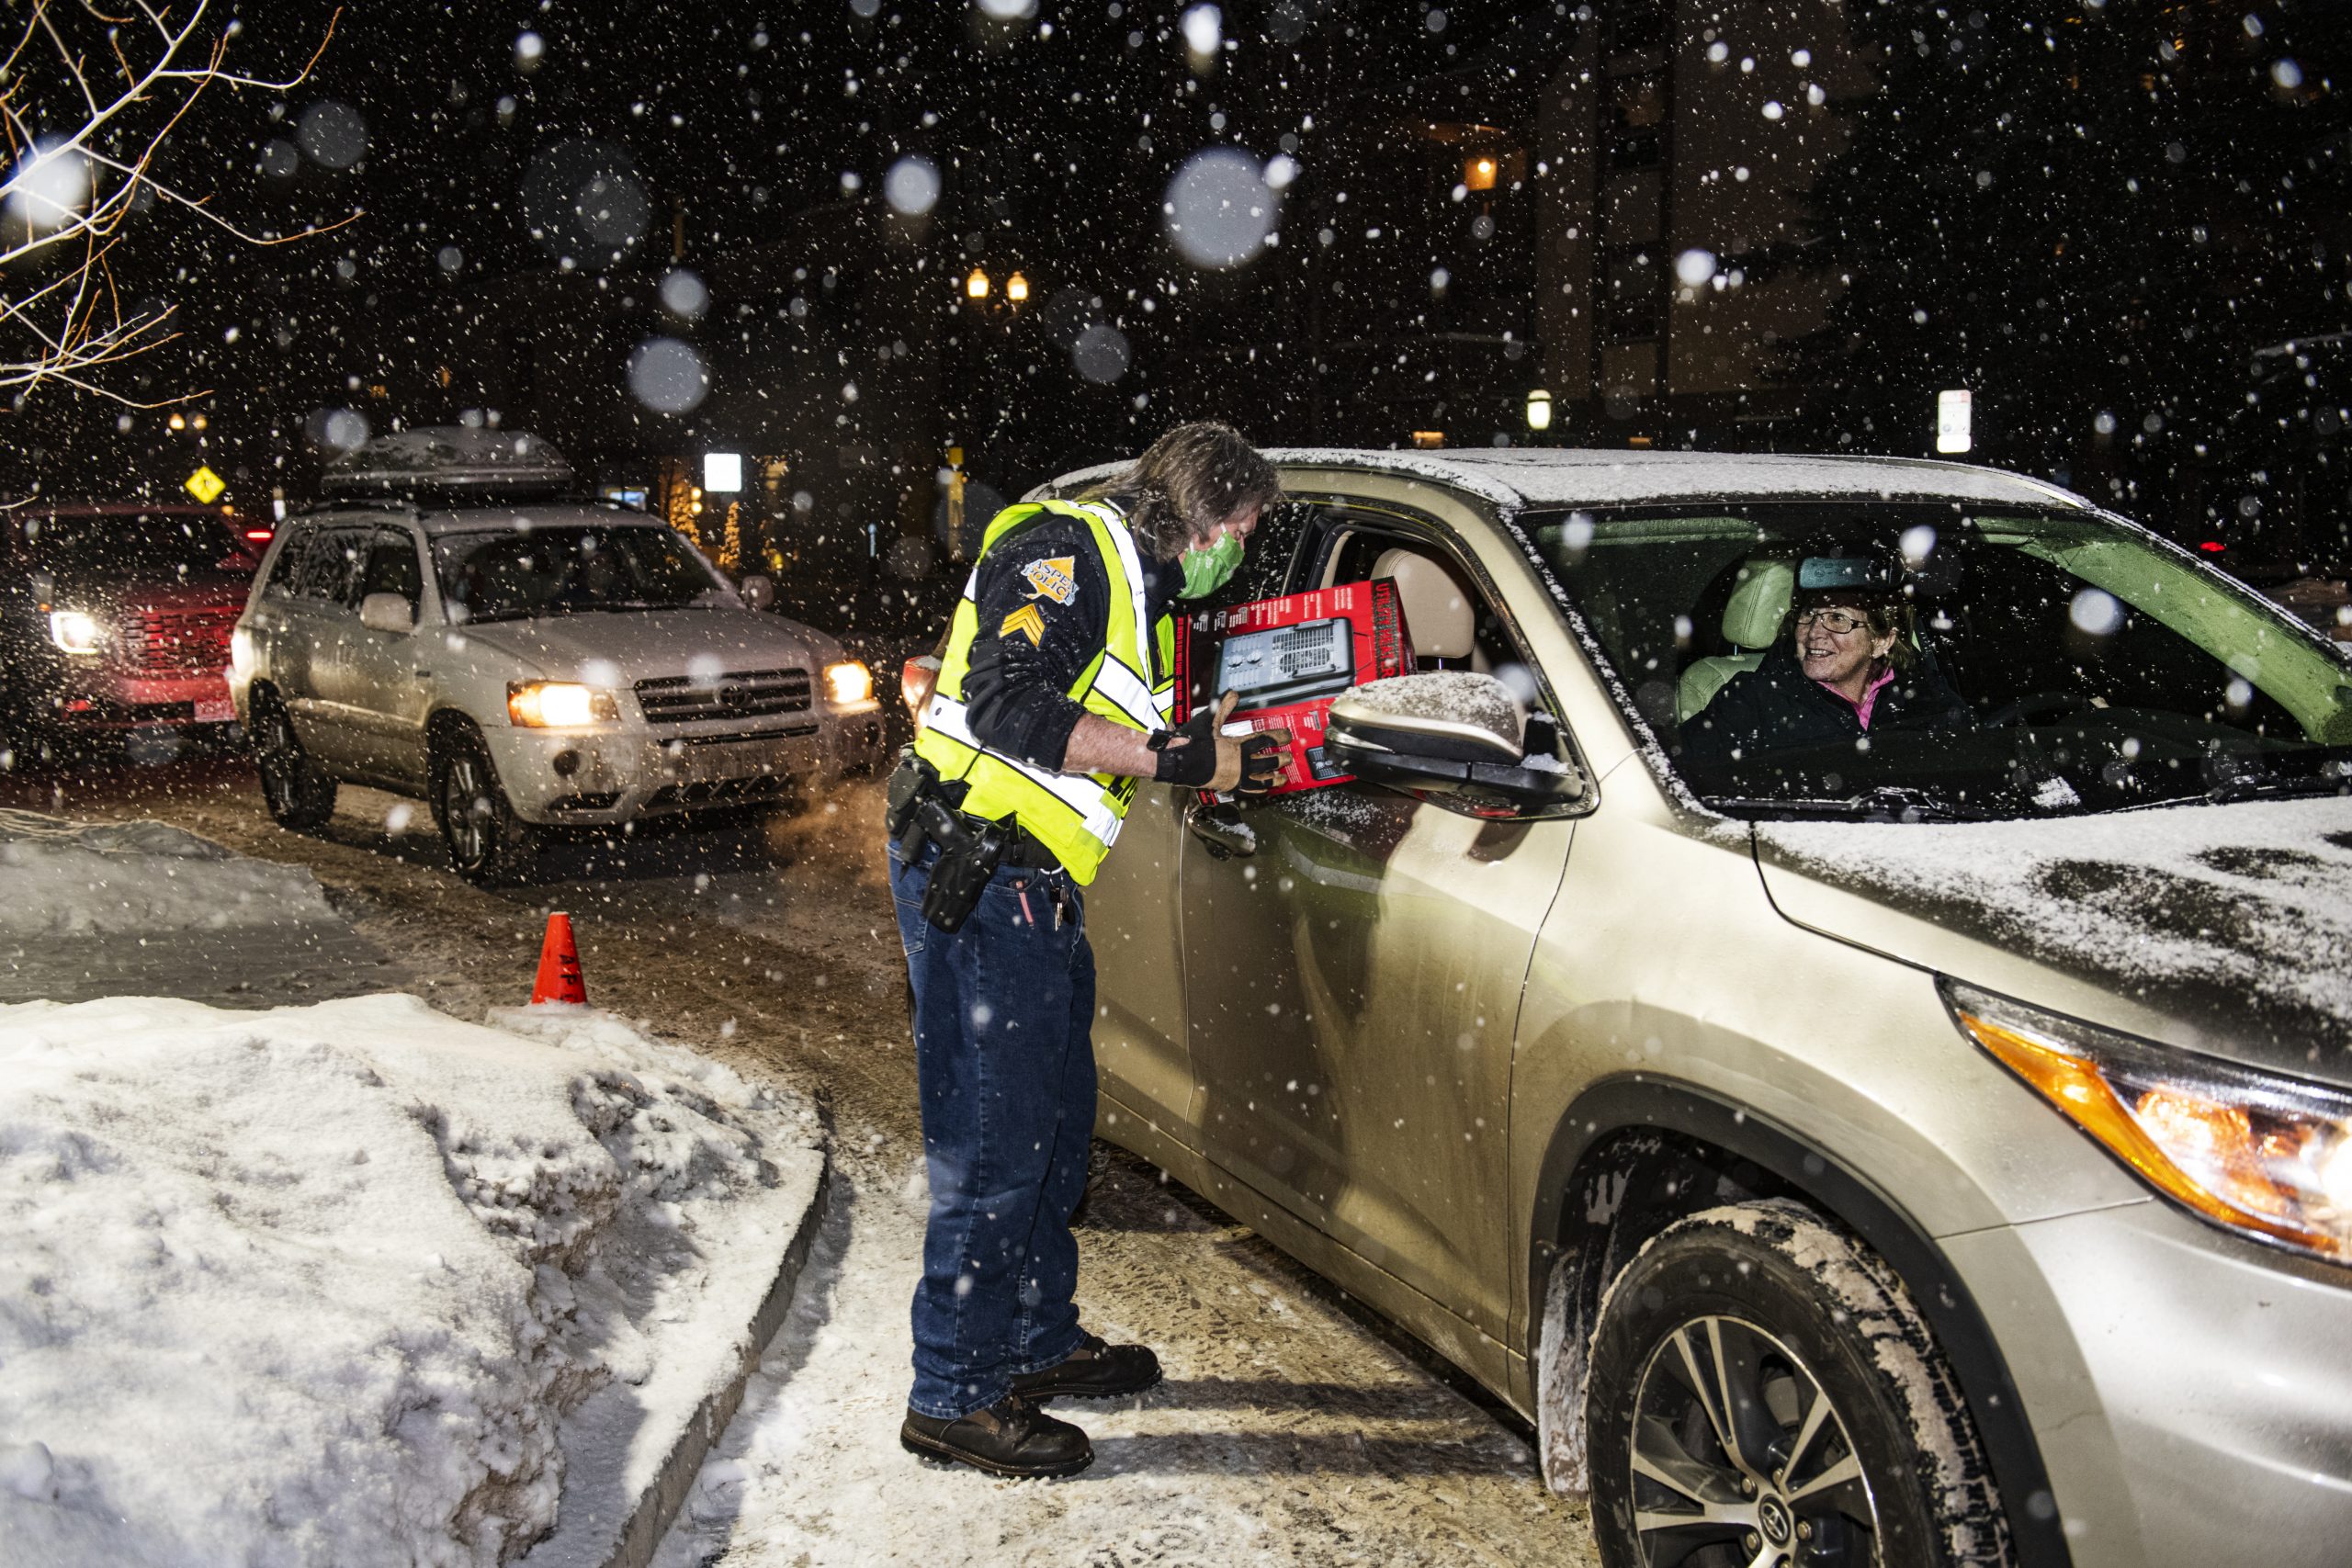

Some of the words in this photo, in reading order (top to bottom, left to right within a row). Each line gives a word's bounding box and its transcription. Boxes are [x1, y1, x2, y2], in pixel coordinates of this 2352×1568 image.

[1023, 566, 1074, 604] POLICE
[1030, 559, 1079, 593] ASPEN
[1375, 582, 1393, 625] UTILITY
